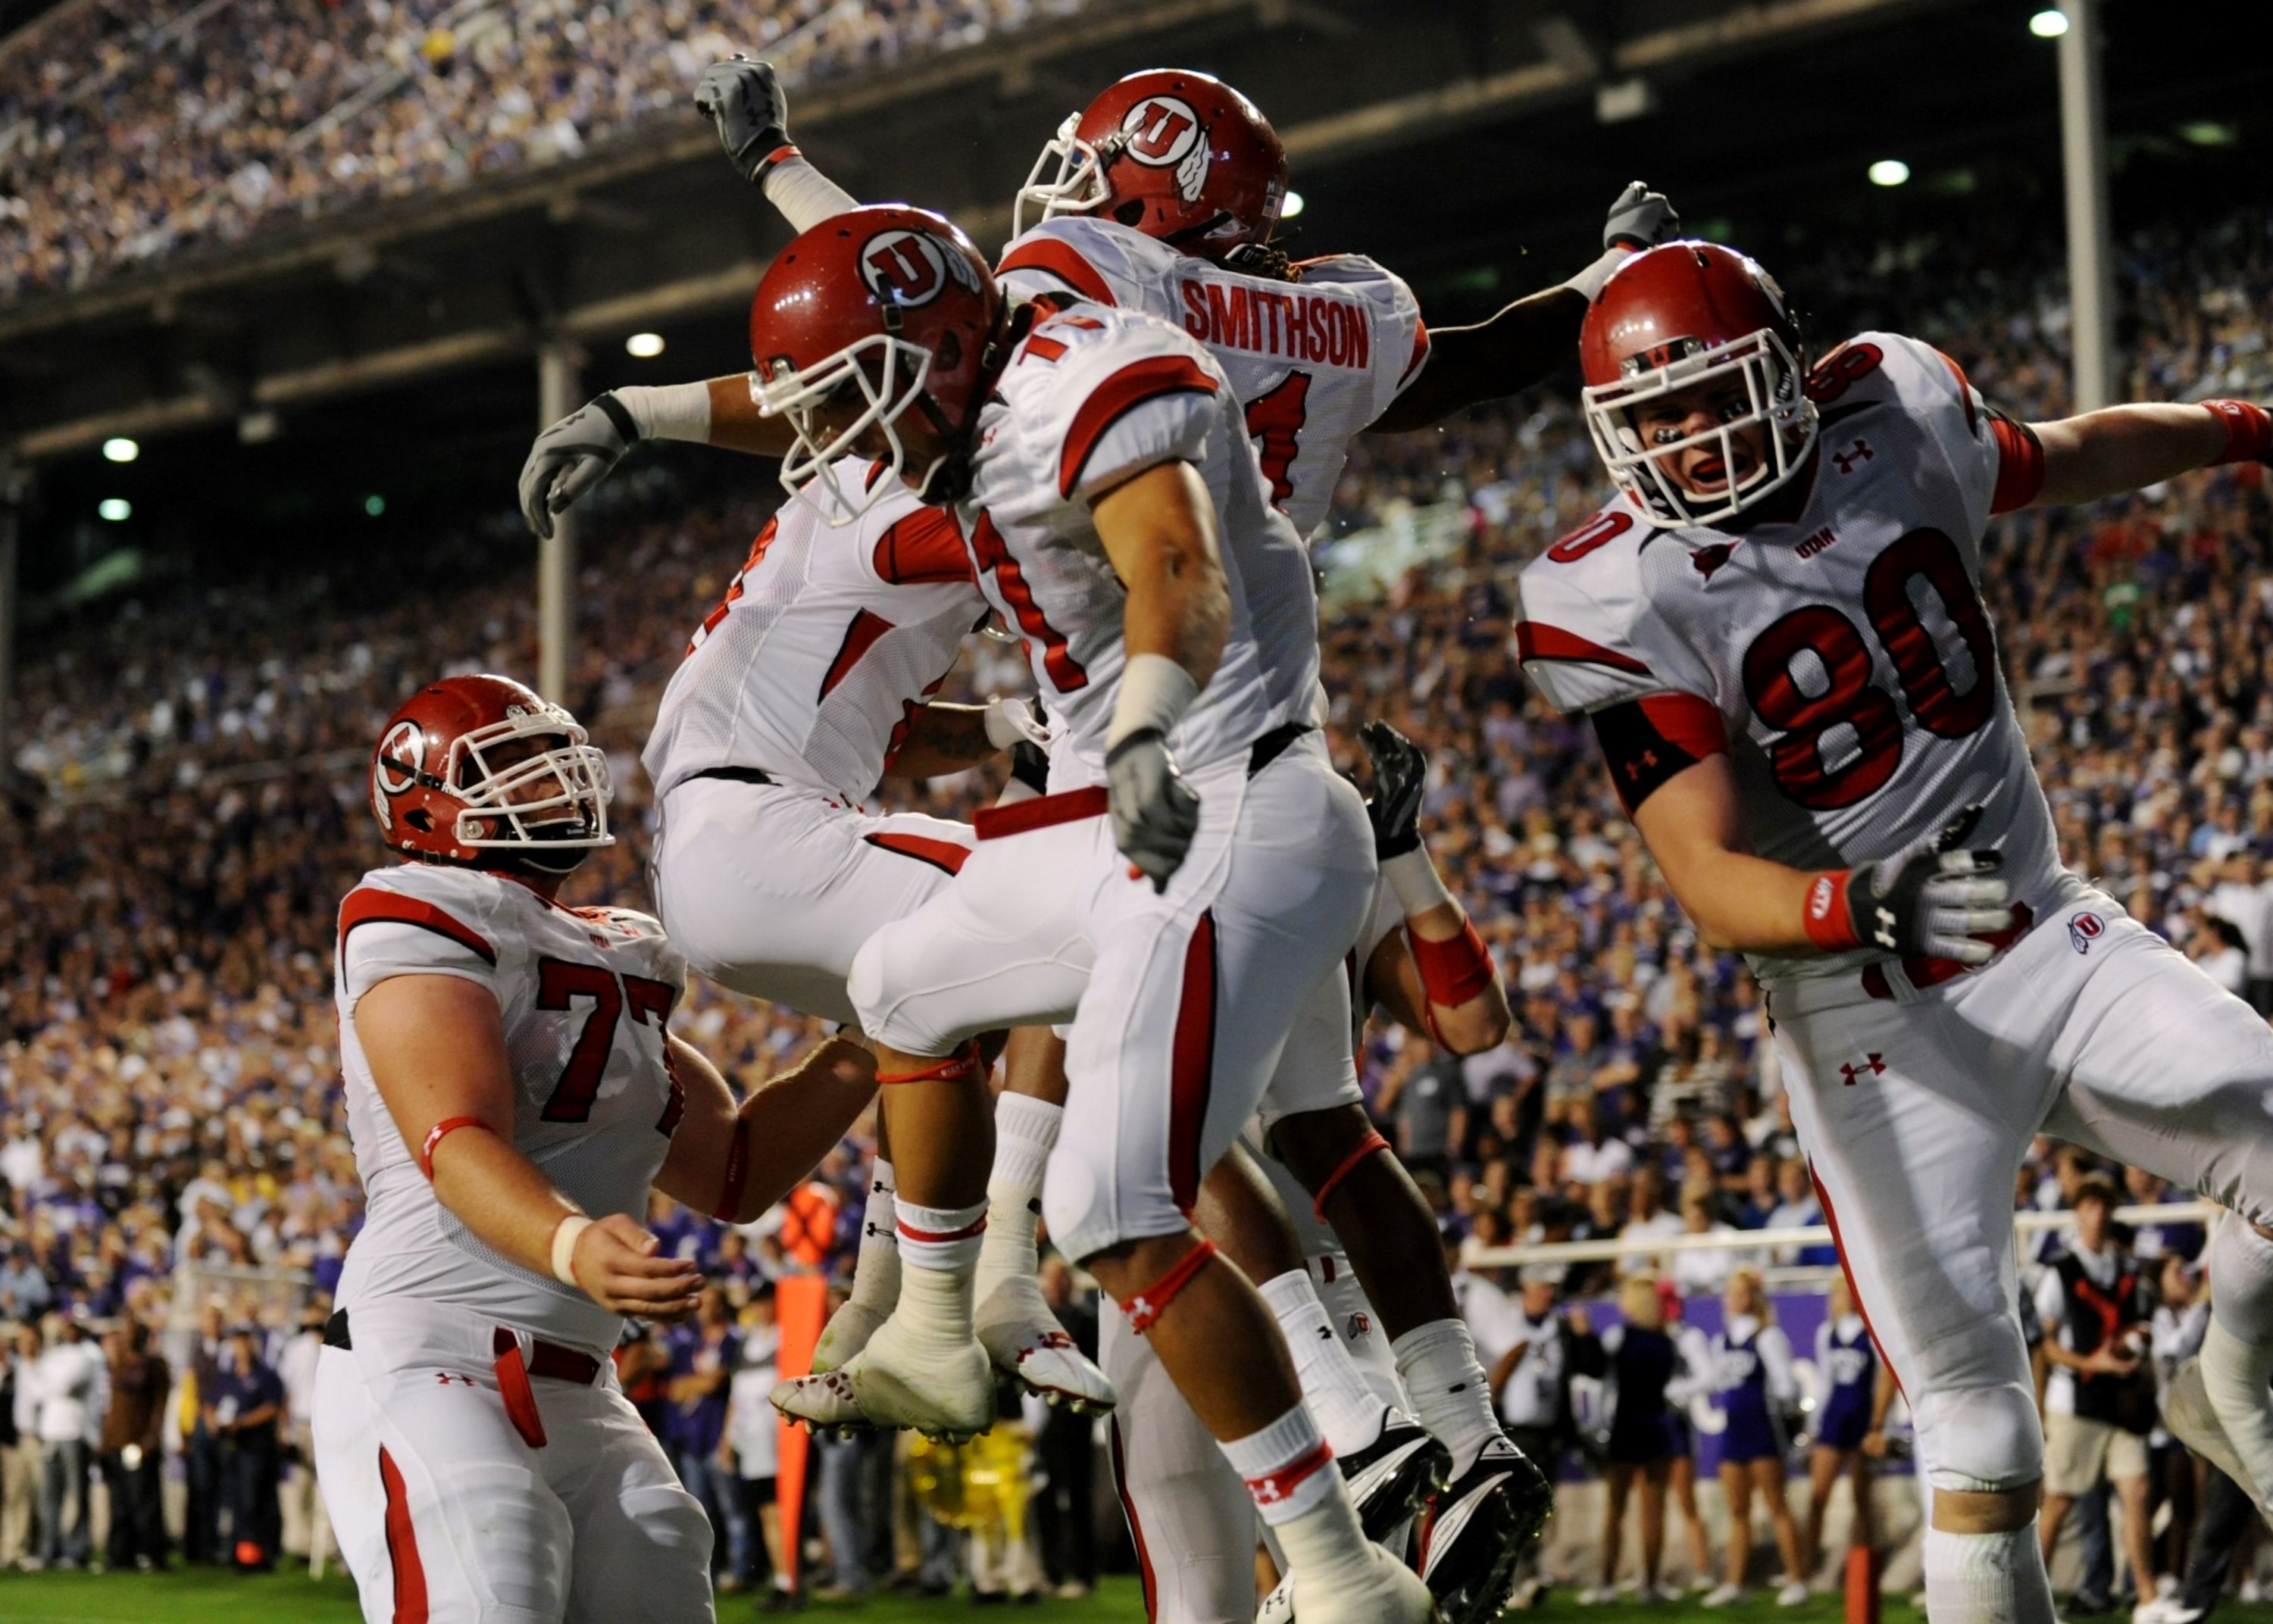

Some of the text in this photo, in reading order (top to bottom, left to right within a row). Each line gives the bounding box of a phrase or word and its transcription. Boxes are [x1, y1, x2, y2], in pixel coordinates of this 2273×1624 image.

[1131, 101, 1193, 159] U
[866, 235, 937, 301] U
[1181, 279, 1369, 369] SMITHSON
[1244, 369, 1313, 506] 1
[1794, 526, 1837, 560] UTAH
[1742, 526, 1996, 812] 80
[2074, 914, 2101, 937] U
[536, 955, 686, 1140] 77
